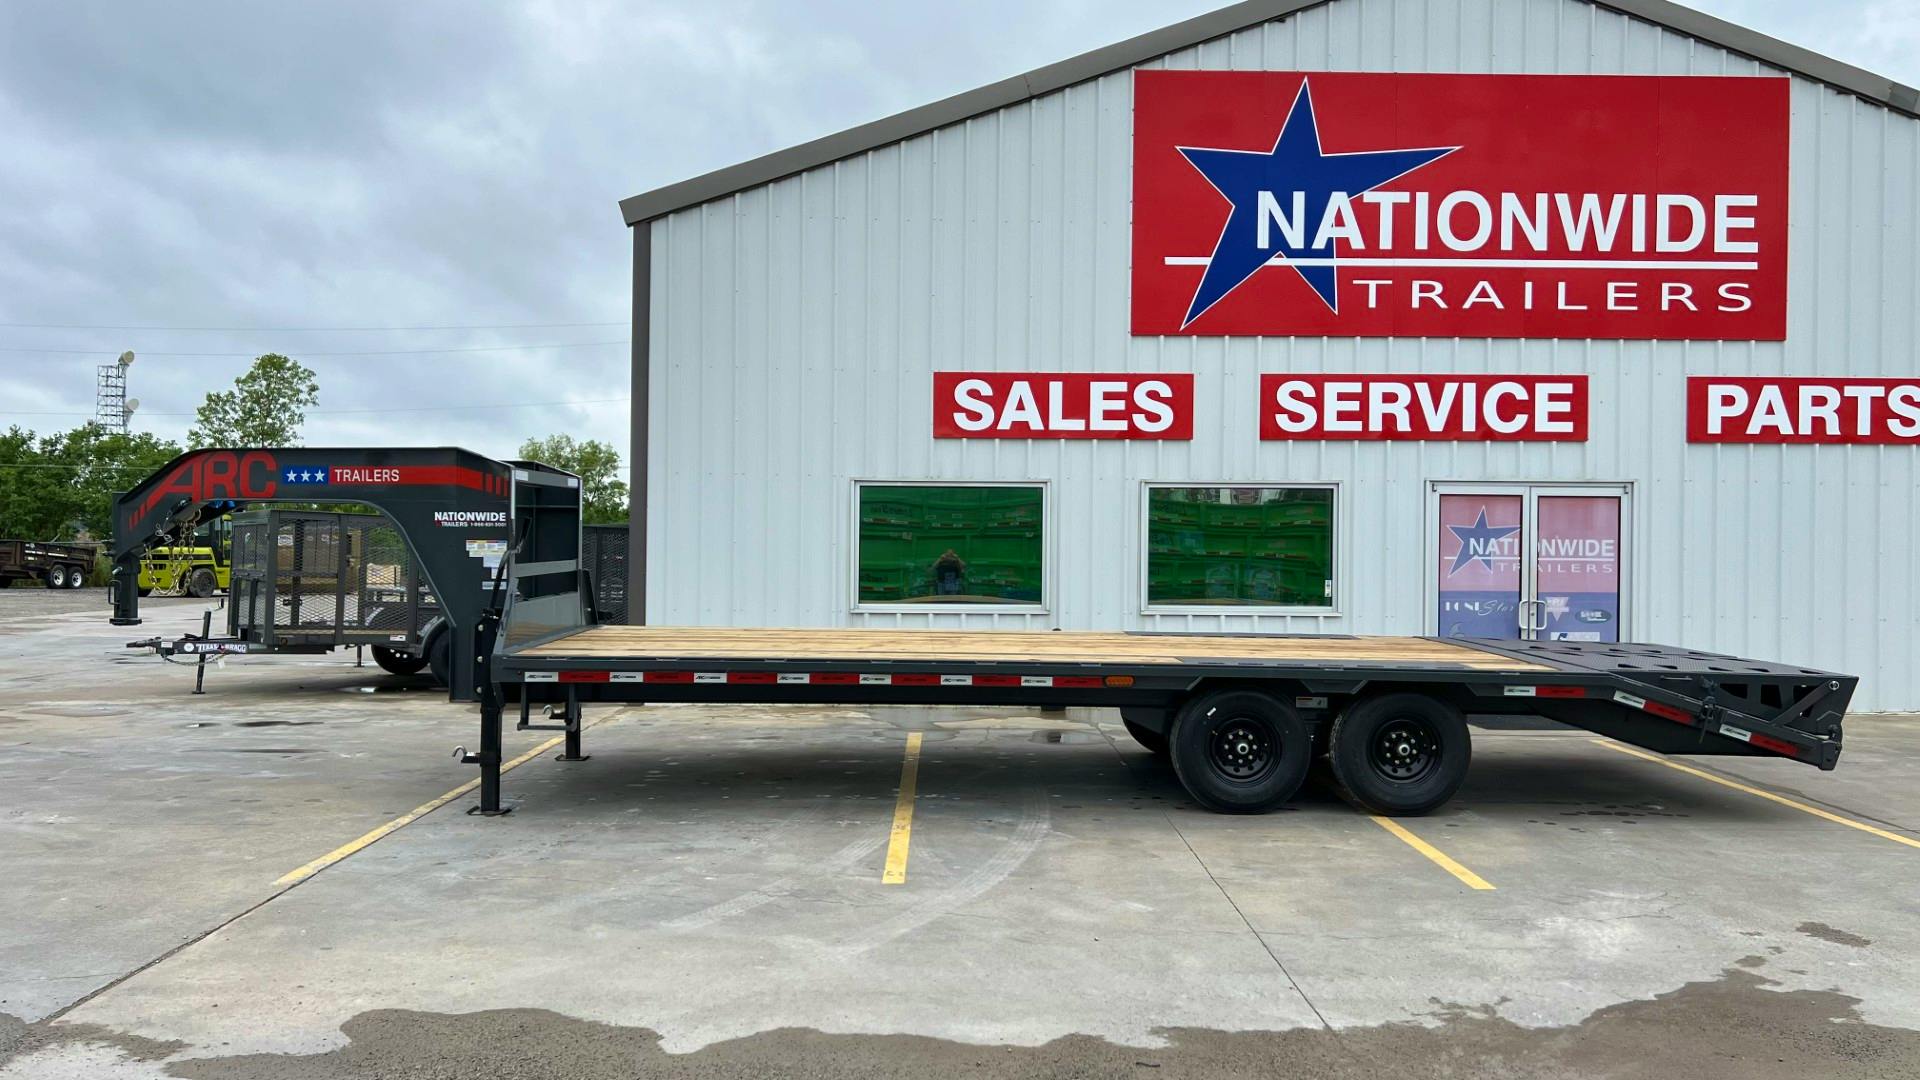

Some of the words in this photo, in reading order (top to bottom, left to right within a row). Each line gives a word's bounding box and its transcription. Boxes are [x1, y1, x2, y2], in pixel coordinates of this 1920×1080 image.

[1257, 189, 1759, 254] NATIONWIDE
[1352, 279, 1753, 312] TRAILERS
[953, 379, 1174, 432] SALES
[1275, 380, 1574, 433] SERVICE
[1707, 384, 1920, 437] PARTS
[142, 449, 278, 505] ARC
[334, 469, 400, 482] TRAILERS
[434, 511, 507, 522] NATIONWIDE
[1469, 537, 1615, 556] NATINWIDE
